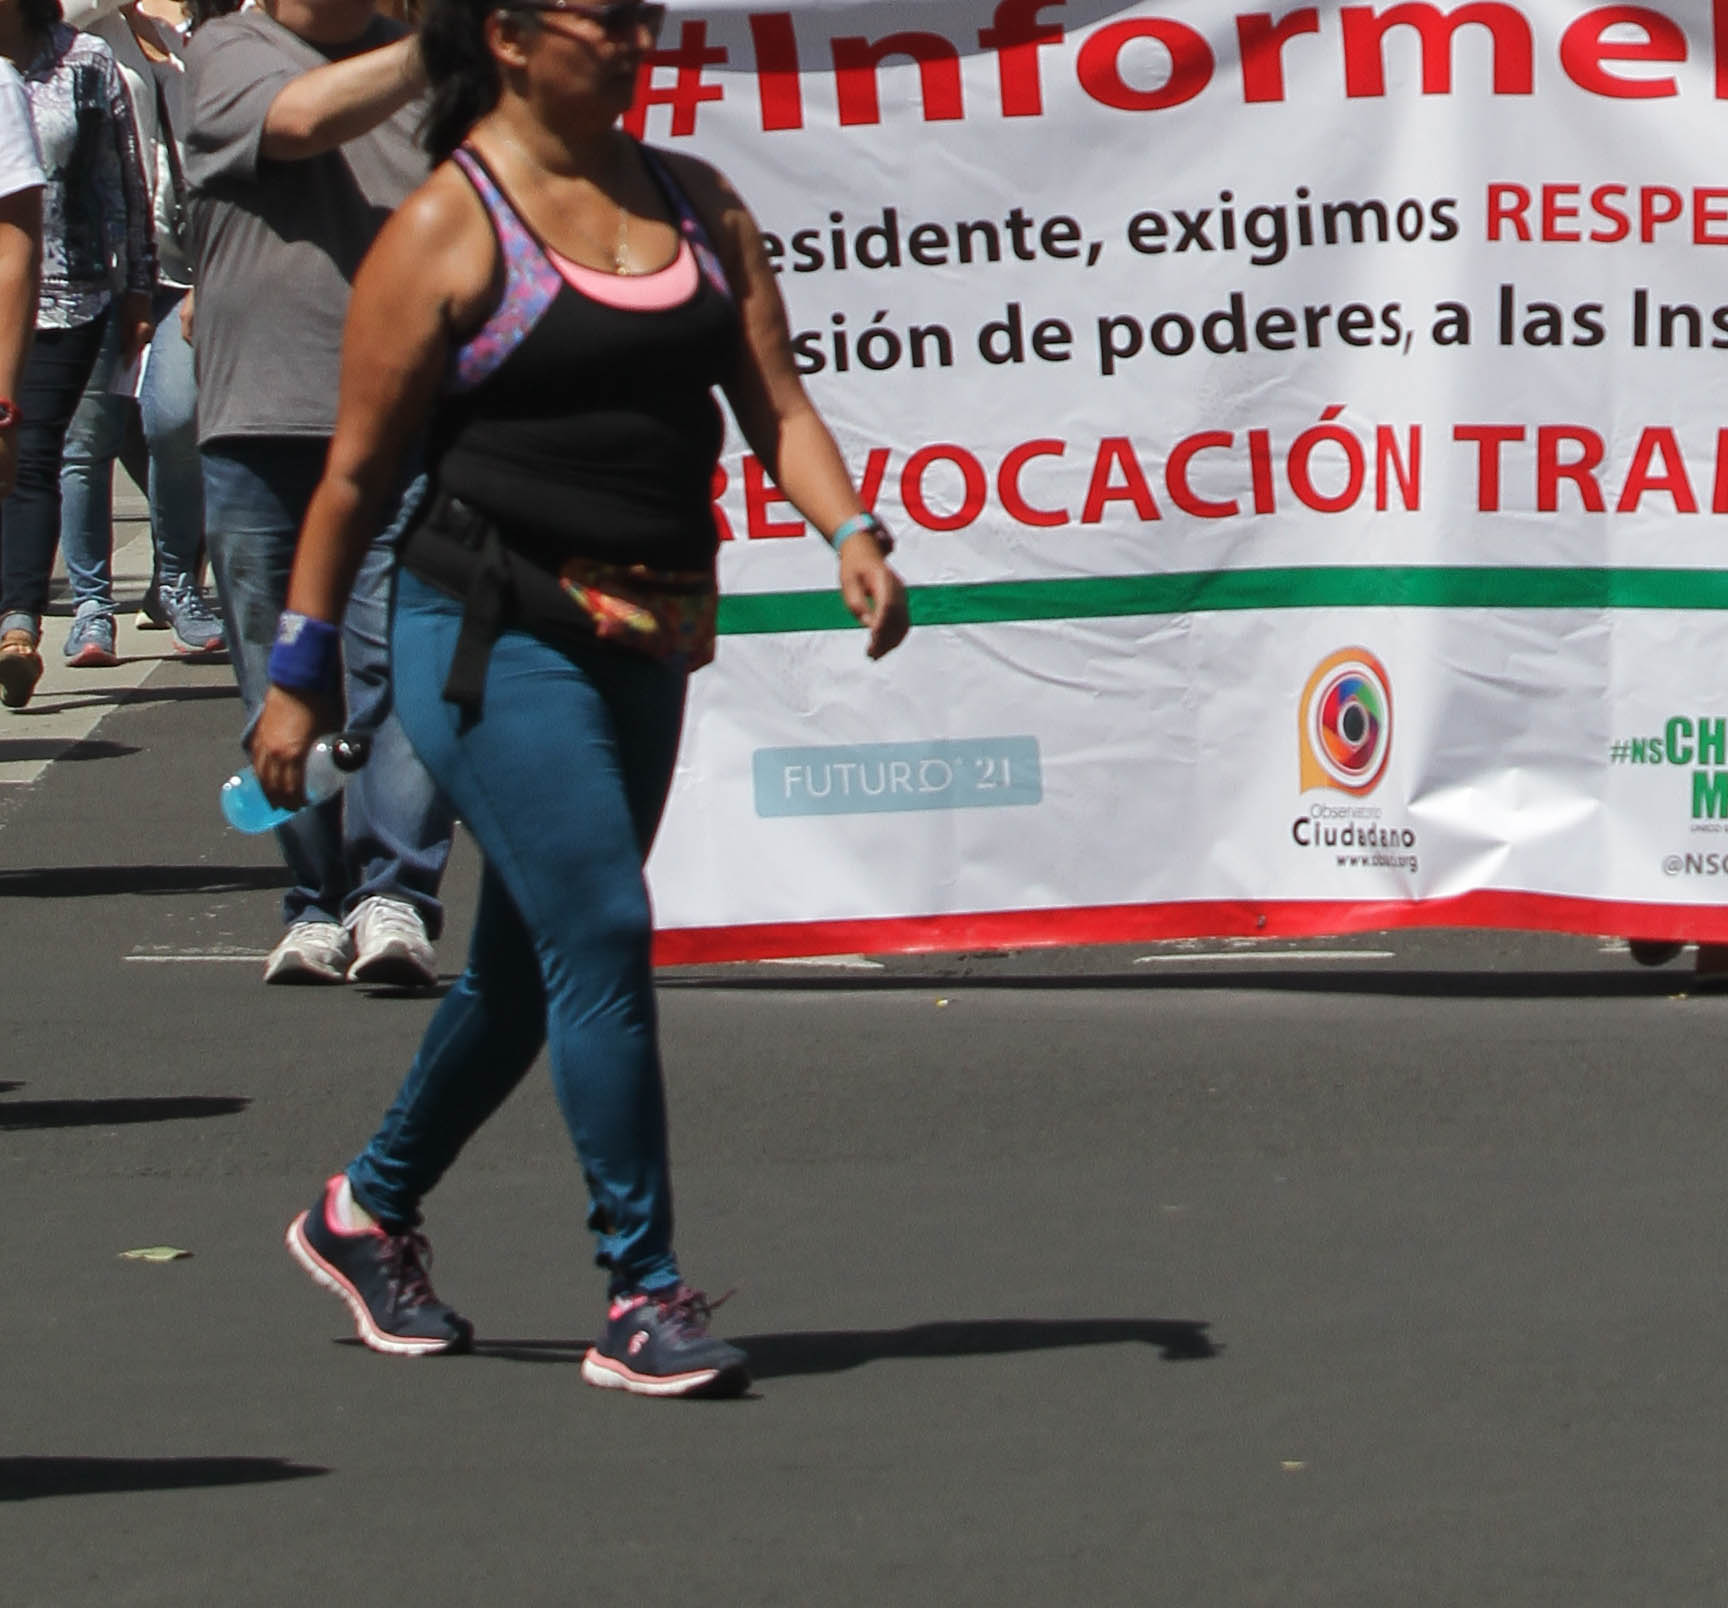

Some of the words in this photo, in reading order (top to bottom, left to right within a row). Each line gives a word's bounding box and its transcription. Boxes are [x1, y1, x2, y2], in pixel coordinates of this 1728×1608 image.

[1127, 187, 1458, 267] exigimos
[978, 303, 1073, 365] de
[1098, 292, 1412, 376] poderes,
[1432, 303, 1470, 346] a
[1500, 285, 1605, 347] las
[783, 758, 953, 799] FUTURO
[975, 756, 1011, 790] 21
[1292, 816, 1415, 847] Ciudadano
